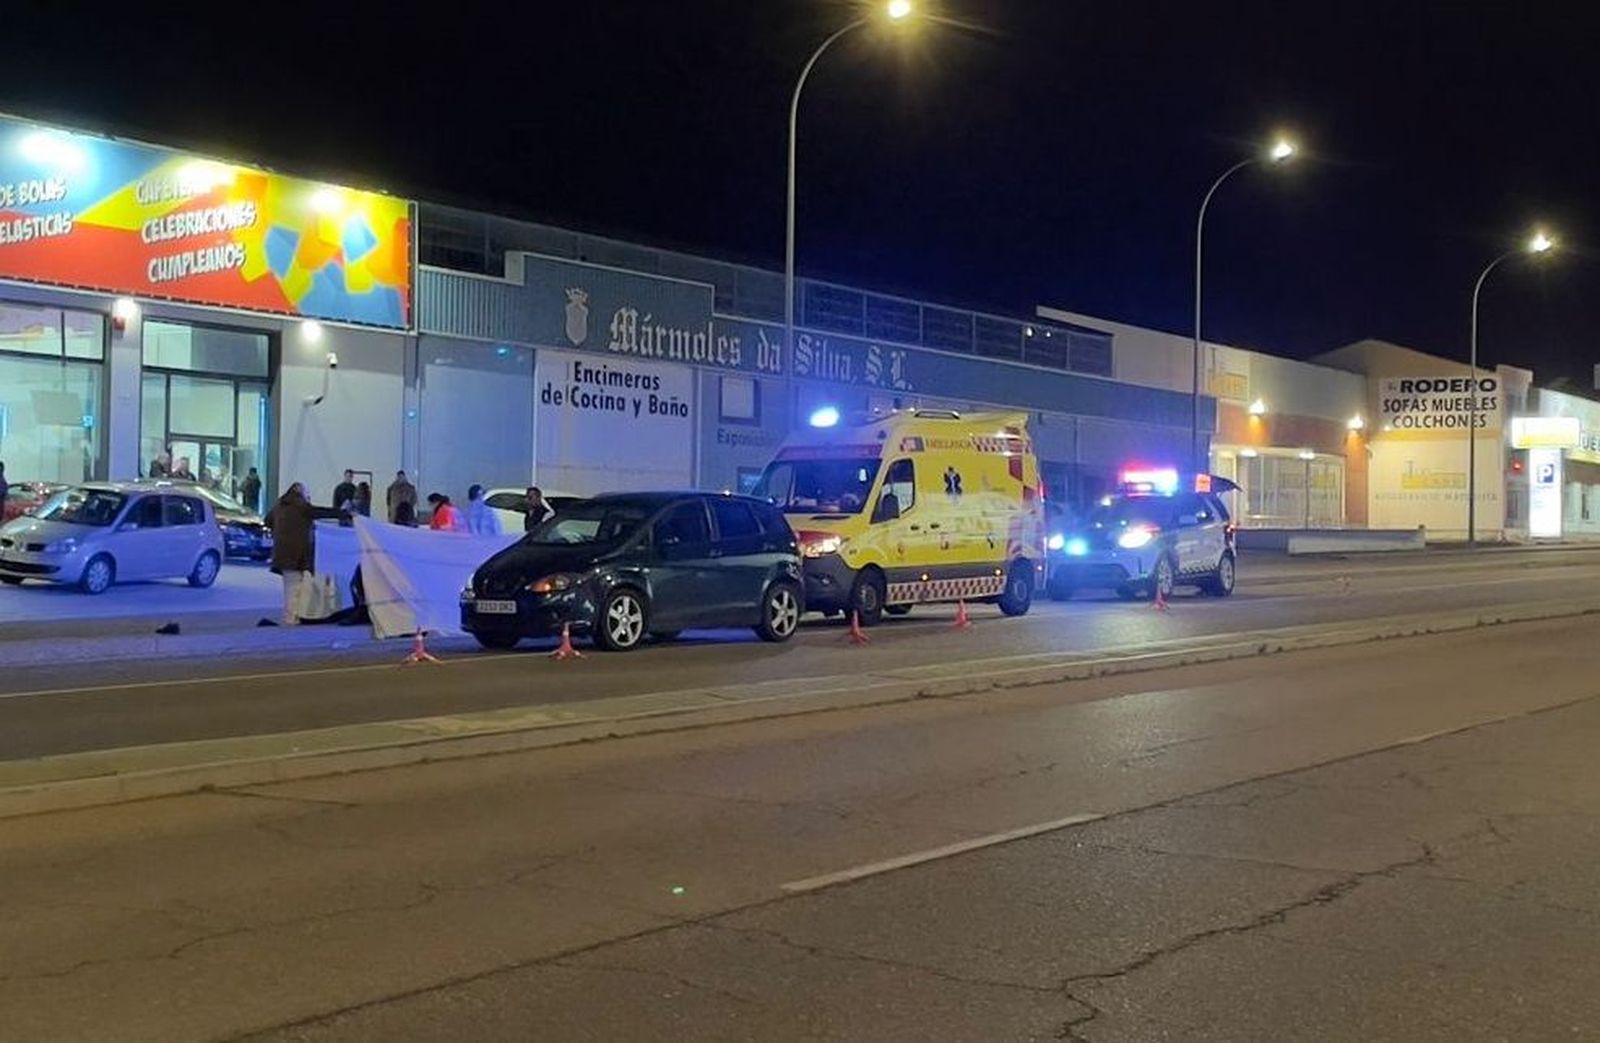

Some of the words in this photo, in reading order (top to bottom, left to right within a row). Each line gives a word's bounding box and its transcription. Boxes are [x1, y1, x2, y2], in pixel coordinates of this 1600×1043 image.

[19, 177, 67, 206] BOLAS
[142, 199, 257, 244] CELEBRACIONES
[609, 307, 740, 366] Mármoles
[757, 328, 781, 372] da
[574, 361, 660, 391] Encimeras
[1401, 379, 1497, 393] RODERO
[541, 382, 563, 406] de
[570, 386, 626, 412] Cocina
[633, 399, 641, 418] y
[649, 394, 689, 417] Baño
[1383, 399, 1427, 413] SOFAS
[1432, 397, 1497, 412] MUEBLES
[1393, 414, 1486, 428] COLCHONES
